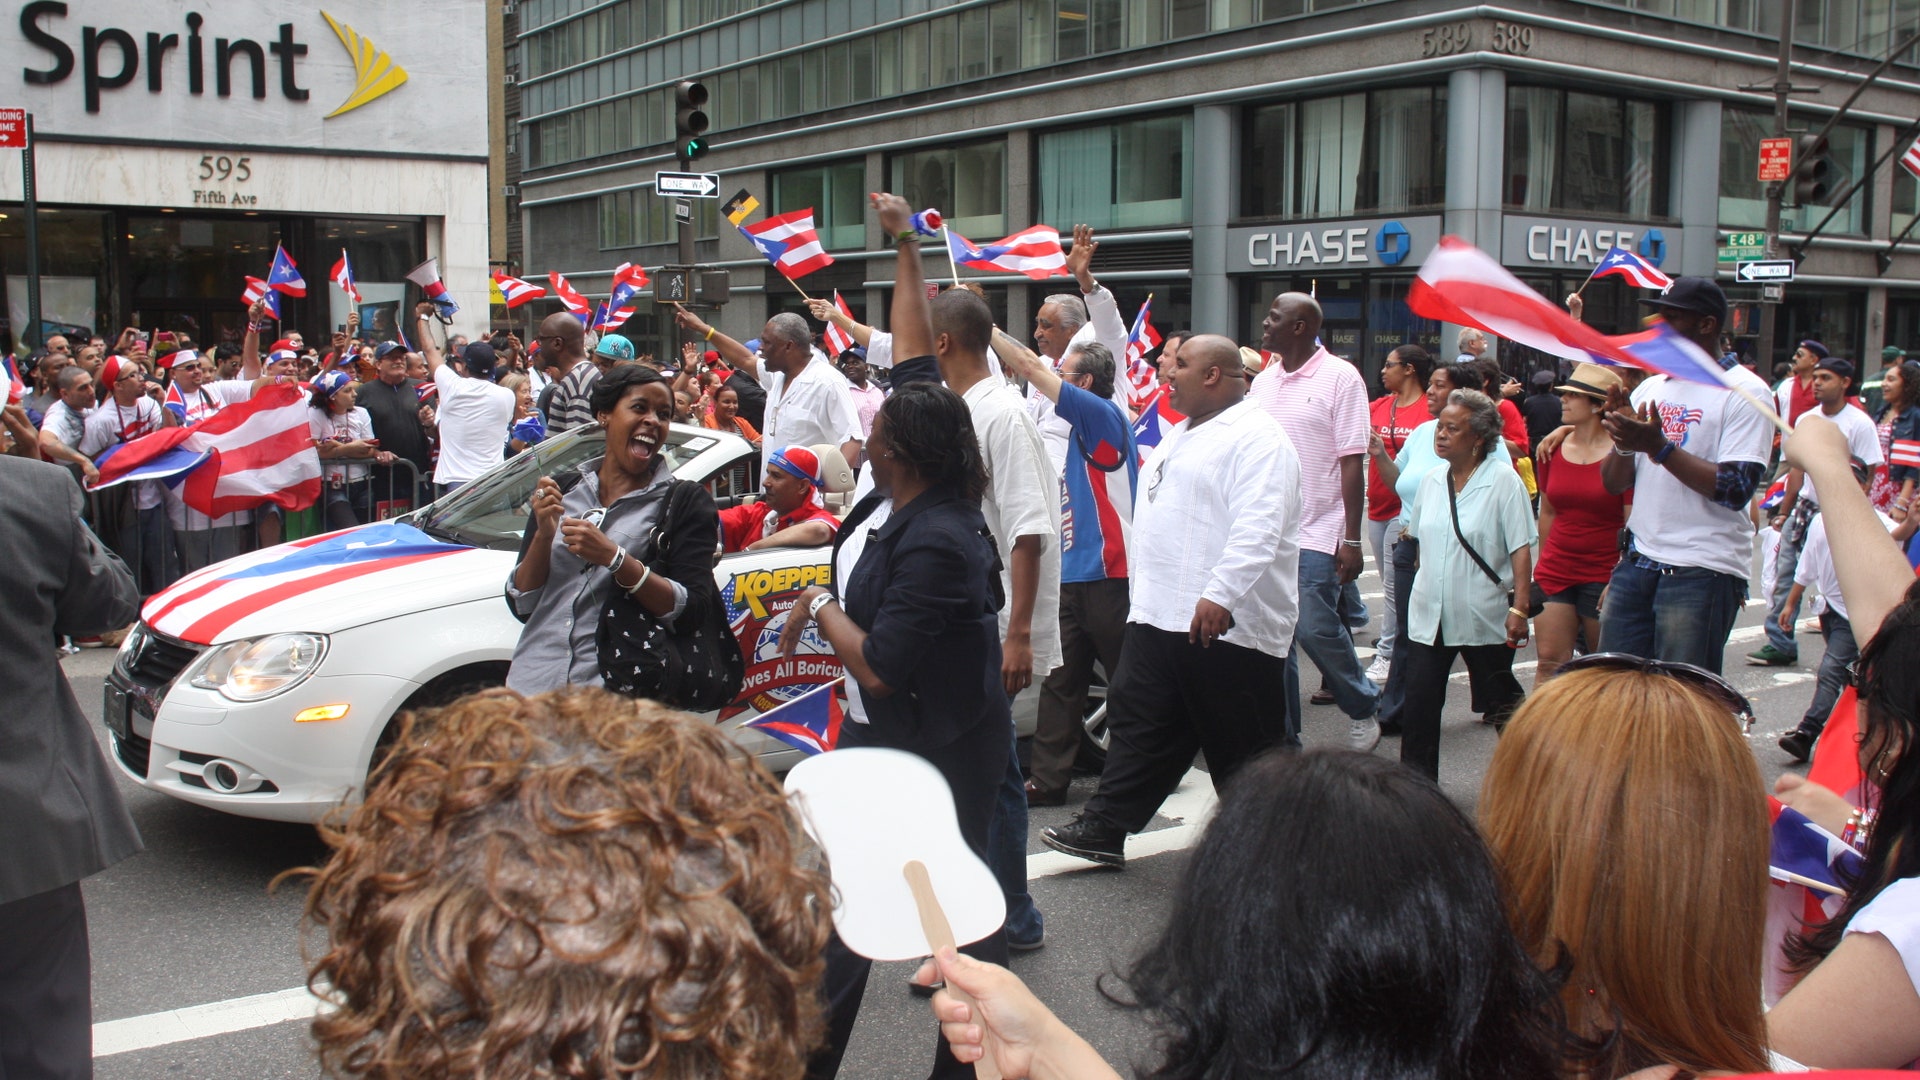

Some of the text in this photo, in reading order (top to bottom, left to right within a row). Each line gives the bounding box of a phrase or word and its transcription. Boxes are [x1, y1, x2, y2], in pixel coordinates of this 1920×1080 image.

[1422, 24, 1470, 57] 589
[1493, 22, 1535, 55] 589
[20, 0, 310, 113] Sprint
[199, 156, 252, 182] 595
[666, 180, 710, 191] ONE WAY
[193, 190, 257, 205] Fifth Ave
[1248, 227, 1369, 266] CHASE
[1527, 225, 1634, 263] CHASE
[1730, 234, 1737, 246] E
[1739, 234, 1755, 246] 48
[1745, 266, 1786, 276] ONE WAY
[1332, 334, 1355, 345] HASE
[1374, 335, 1401, 345] CHASE
[774, 661, 794, 680] All
